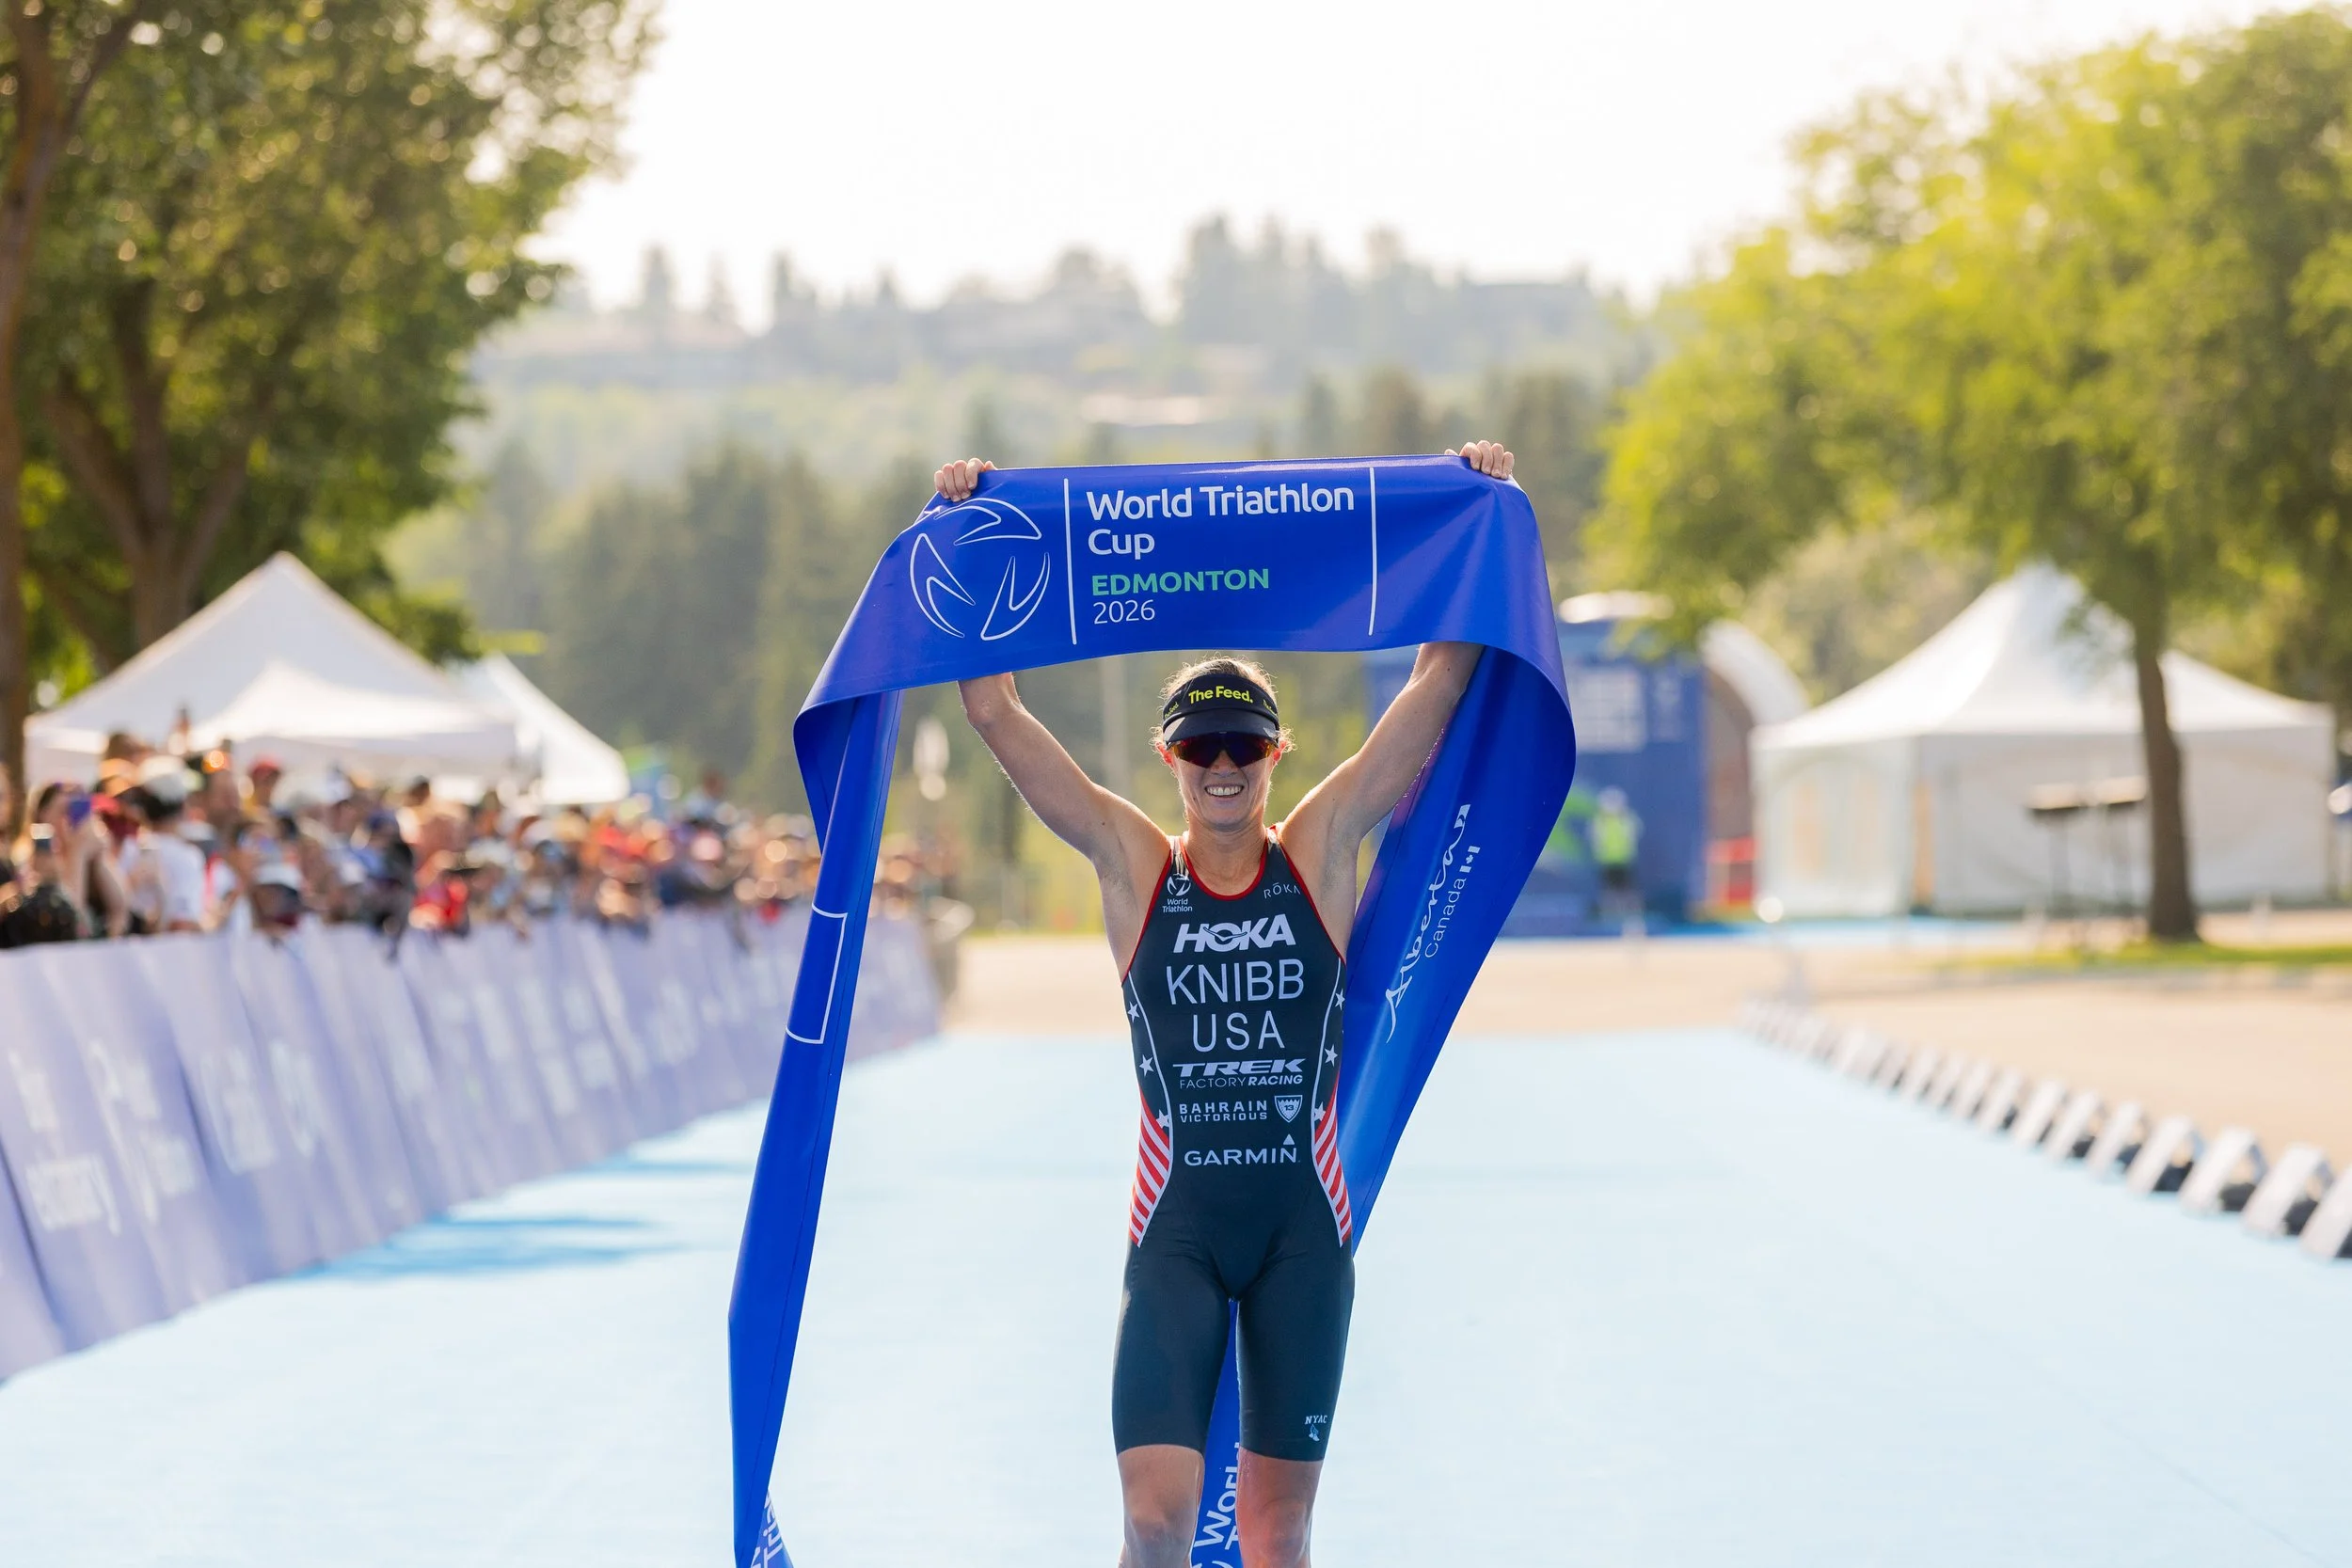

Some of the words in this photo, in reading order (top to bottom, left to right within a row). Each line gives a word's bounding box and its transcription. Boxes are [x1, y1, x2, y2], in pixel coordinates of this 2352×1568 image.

[1087, 487, 1193, 521] World
[1200, 483, 1355, 516] Triathlon
[1088, 529, 1155, 561] Cup
[1091, 568, 1269, 596] EDMONTON
[1092, 599, 1155, 625] 2026
[1188, 689, 1214, 705] The
[1162, 905, 1193, 913] Triathlon
[1424, 878, 1467, 958] Canada
[1172, 913, 1296, 954] HOKA
[1166, 958, 1305, 1006] KNIBB
[1193, 1010, 1286, 1053] USA
[1172, 1058, 1307, 1078] TREK
[1180, 1077, 1247, 1089] FACTORY
[1248, 1074, 1303, 1086] RACING
[1179, 1100, 1267, 1115] BAHRAIN
[1180, 1112, 1267, 1123] VICTORIOUS
[1184, 1148, 1297, 1166] GARMIN
[1304, 1414, 1328, 1425] NYAC
